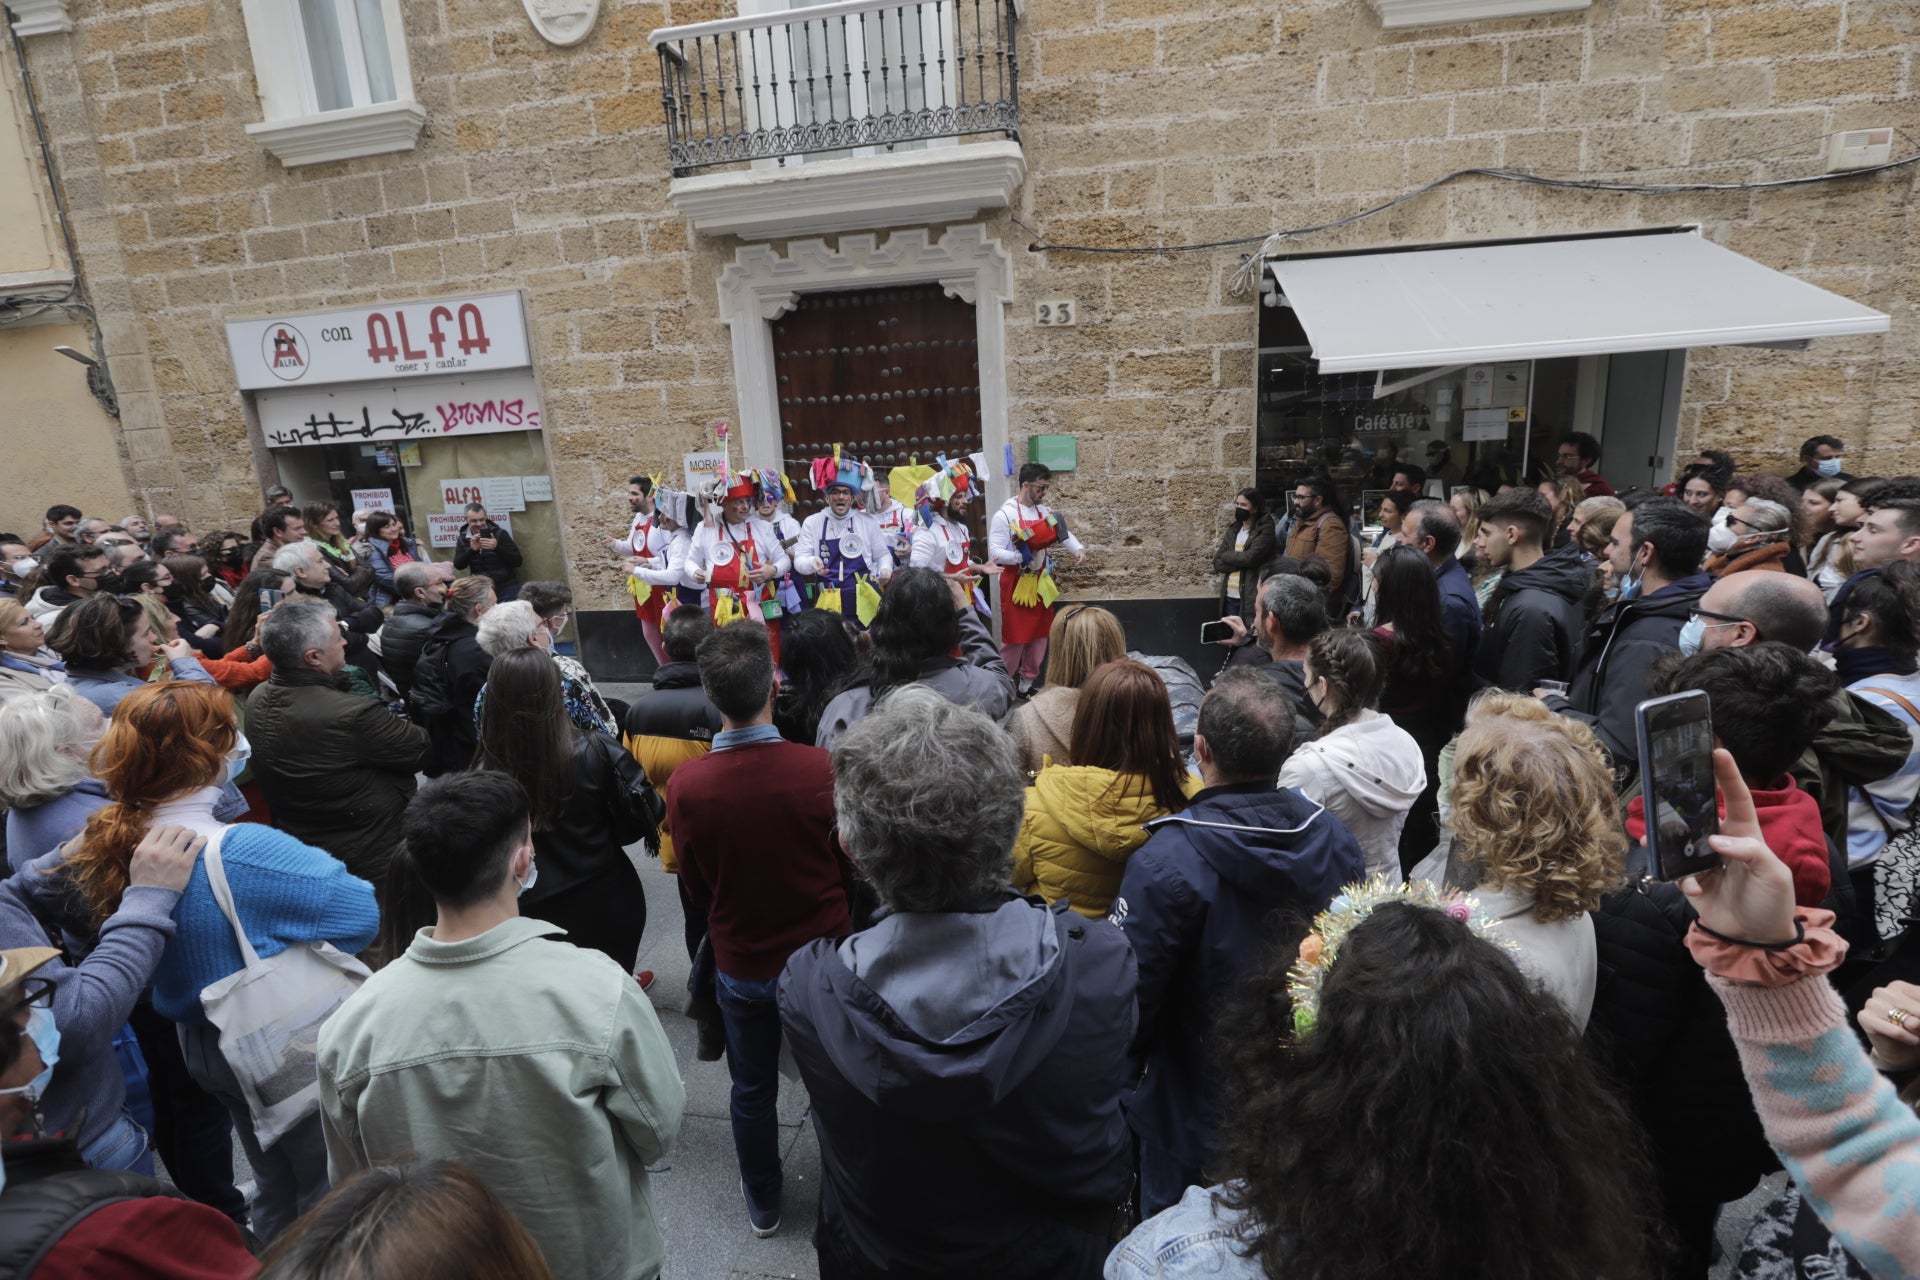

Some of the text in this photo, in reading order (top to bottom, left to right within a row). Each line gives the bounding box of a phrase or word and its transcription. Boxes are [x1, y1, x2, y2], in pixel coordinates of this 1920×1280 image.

[320, 302, 491, 364] con ALFA
[279, 358, 298, 368] ALFA
[394, 356, 468, 373] coser y cantar
[354, 490, 389, 499] PROHIBIDO
[445, 486, 482, 505] ALFA
[429, 515, 466, 524] PROHIBIDO
